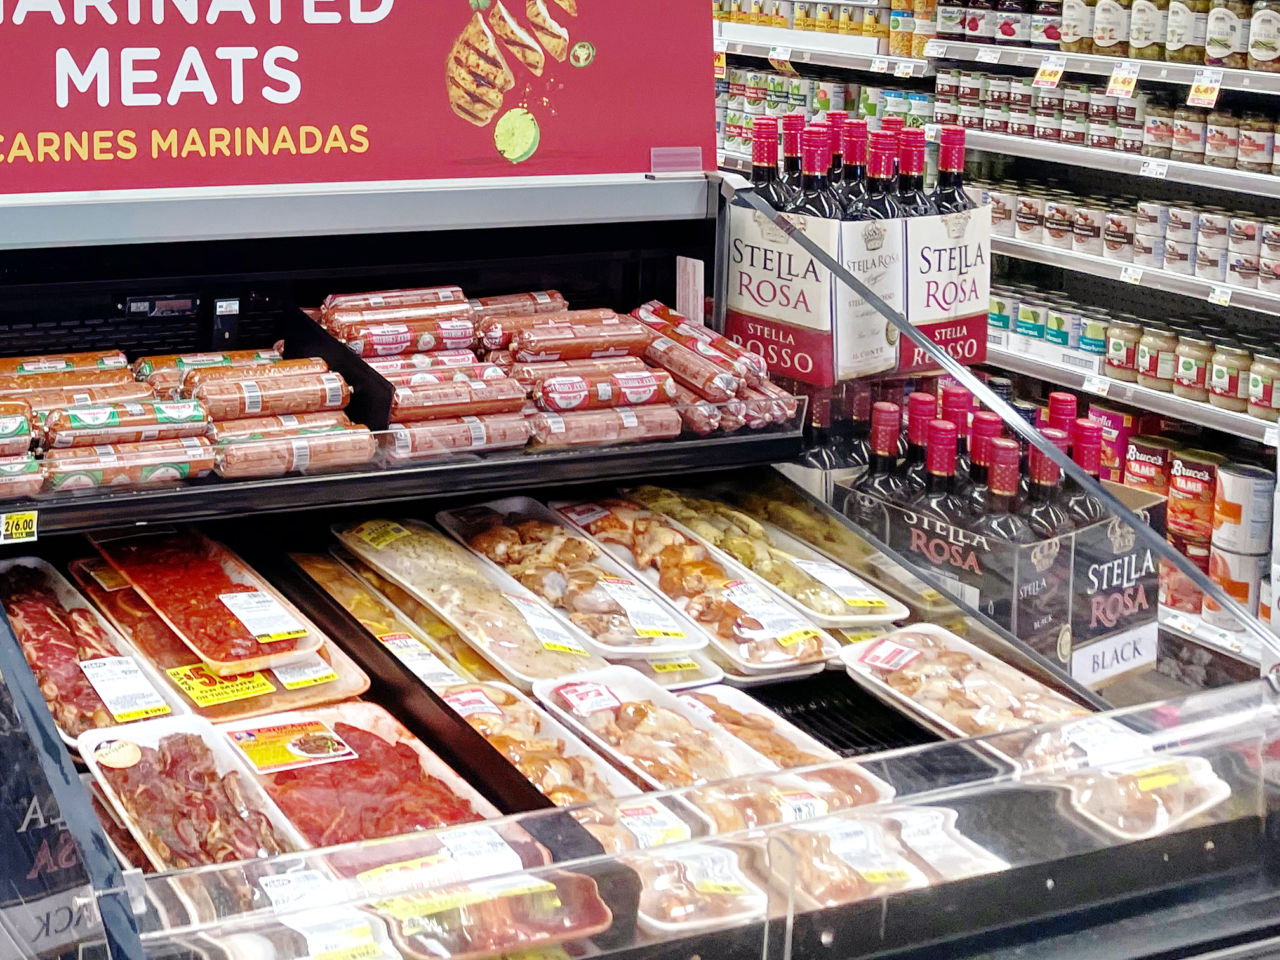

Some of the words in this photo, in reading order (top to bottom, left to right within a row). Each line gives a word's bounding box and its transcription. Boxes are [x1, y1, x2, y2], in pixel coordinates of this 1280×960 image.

[55, 47, 301, 107] MEATS
[1040, 70, 1059, 78] 6.49
[1113, 77, 1132, 86] 6.49
[1195, 86, 1215, 95] 6.49
[151, 124, 370, 158] MARINADAS
[733, 238, 822, 283] STELLA
[846, 257, 877, 273] STELLA
[878, 253, 900, 268] ROSA
[919, 242, 985, 275] STELLA
[738, 270, 812, 313] ROSA
[924, 277, 980, 312] ROSA
[748, 322, 795, 346] STELLA
[934, 325, 967, 341] STELLA
[1126, 445, 1163, 466] Bruce's
[1130, 463, 1155, 477] YAMS
[1171, 459, 1210, 481] Bruce's
[1175, 478, 1202, 490] YAMS
[5, 519, 34, 533] 2/6.00
[908, 527, 983, 575] ROSA
[1087, 548, 1155, 594] STELLA
[1019, 578, 1047, 600] STELLA
[1089, 584, 1149, 628] ROSA
[1034, 615, 1053, 630] BLACK
[1092, 637, 1142, 674] BLACK
